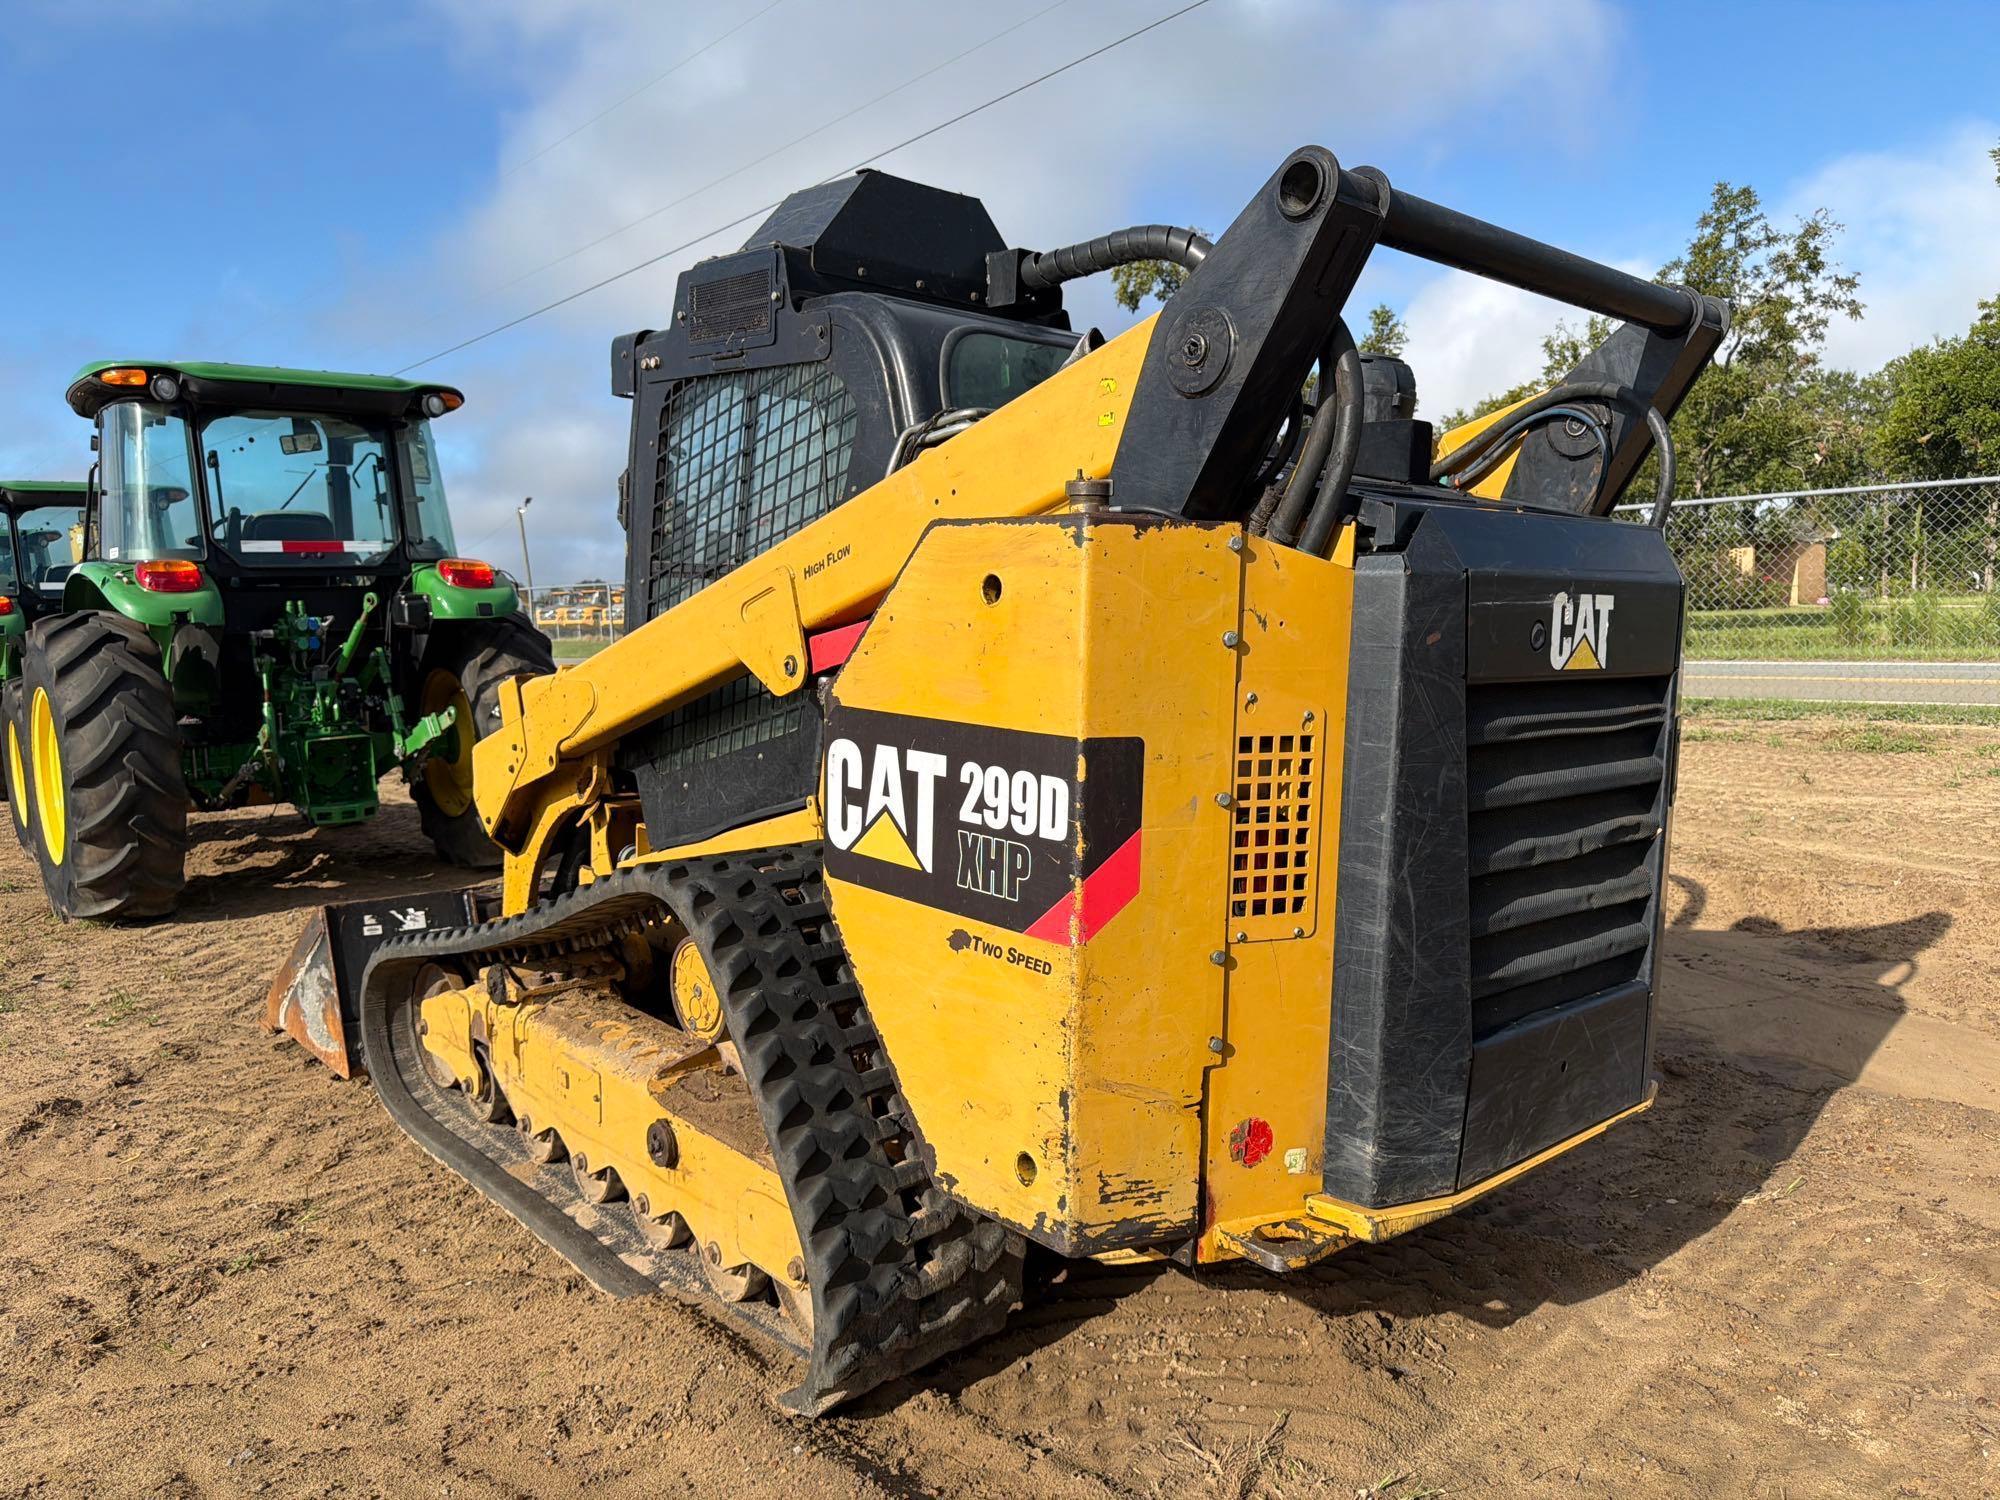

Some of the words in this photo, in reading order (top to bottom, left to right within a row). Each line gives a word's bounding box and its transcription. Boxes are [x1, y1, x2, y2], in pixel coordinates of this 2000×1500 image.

[803, 559, 825, 580] HIGH
[826, 544, 851, 567] FLOW
[1551, 591, 1615, 670] CAT
[827, 738, 947, 873] CAT
[959, 761, 1069, 841] 299D
[957, 829, 1031, 902] XHP
[972, 935, 1003, 959] TWO
[1006, 947, 1052, 976] SPEED
